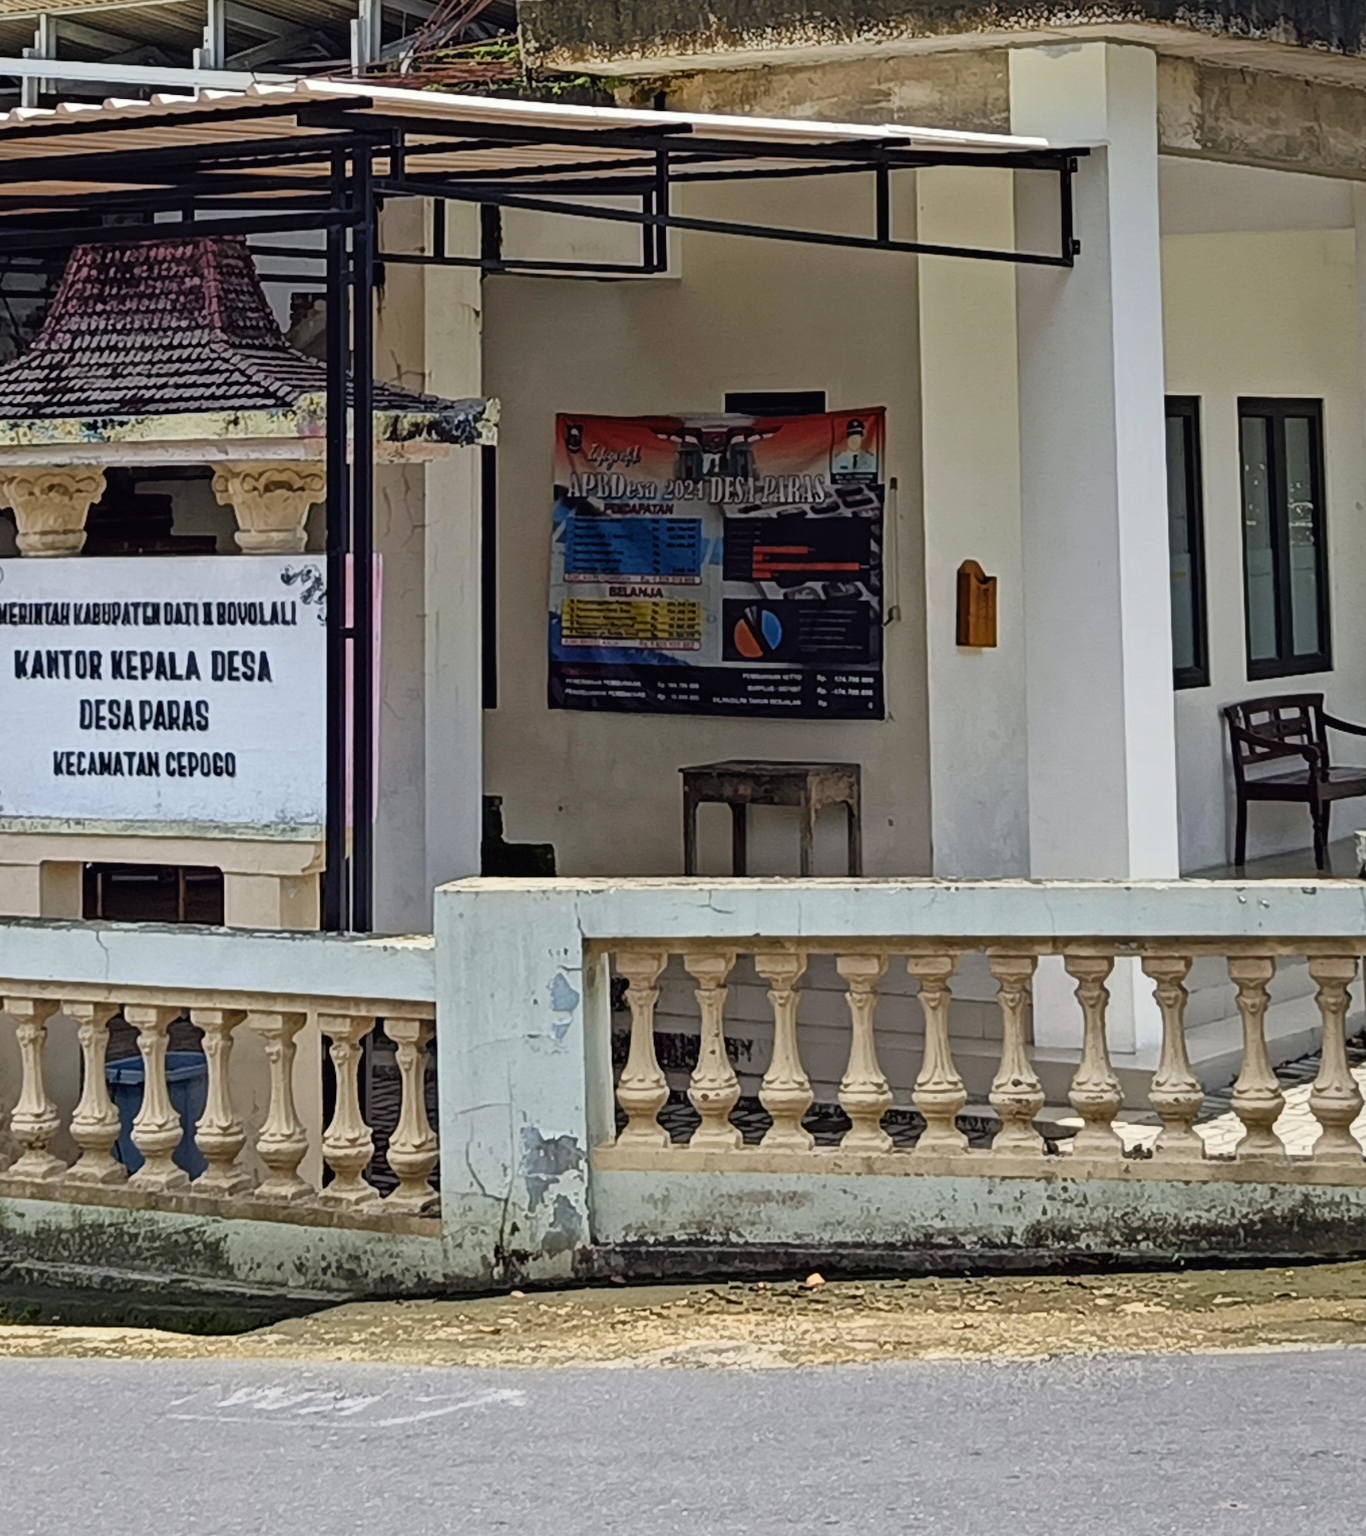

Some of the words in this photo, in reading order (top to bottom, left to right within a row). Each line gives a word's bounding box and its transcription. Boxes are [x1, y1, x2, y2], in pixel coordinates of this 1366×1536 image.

[567, 473, 655, 498] APBDesa
[664, 479, 703, 500] 2024
[710, 476, 755, 504] DESA
[761, 474, 826, 504] PARAS
[604, 502, 674, 515] PENDAPATAN
[609, 586, 664, 599] BELANJA
[73, 601, 160, 626] KABUPATEN
[163, 601, 200, 626] DATI
[202, 601, 214, 626] II
[216, 601, 298, 626] BOYOLALI
[14, 649, 103, 680] KANTOR
[110, 650, 201, 682] KEPALA
[210, 650, 273, 682] DESA
[79, 699, 137, 731] DESA
[139, 699, 210, 731] PARAS
[53, 750, 160, 777] KECAMATAN
[165, 751, 237, 778] CEPOGO
